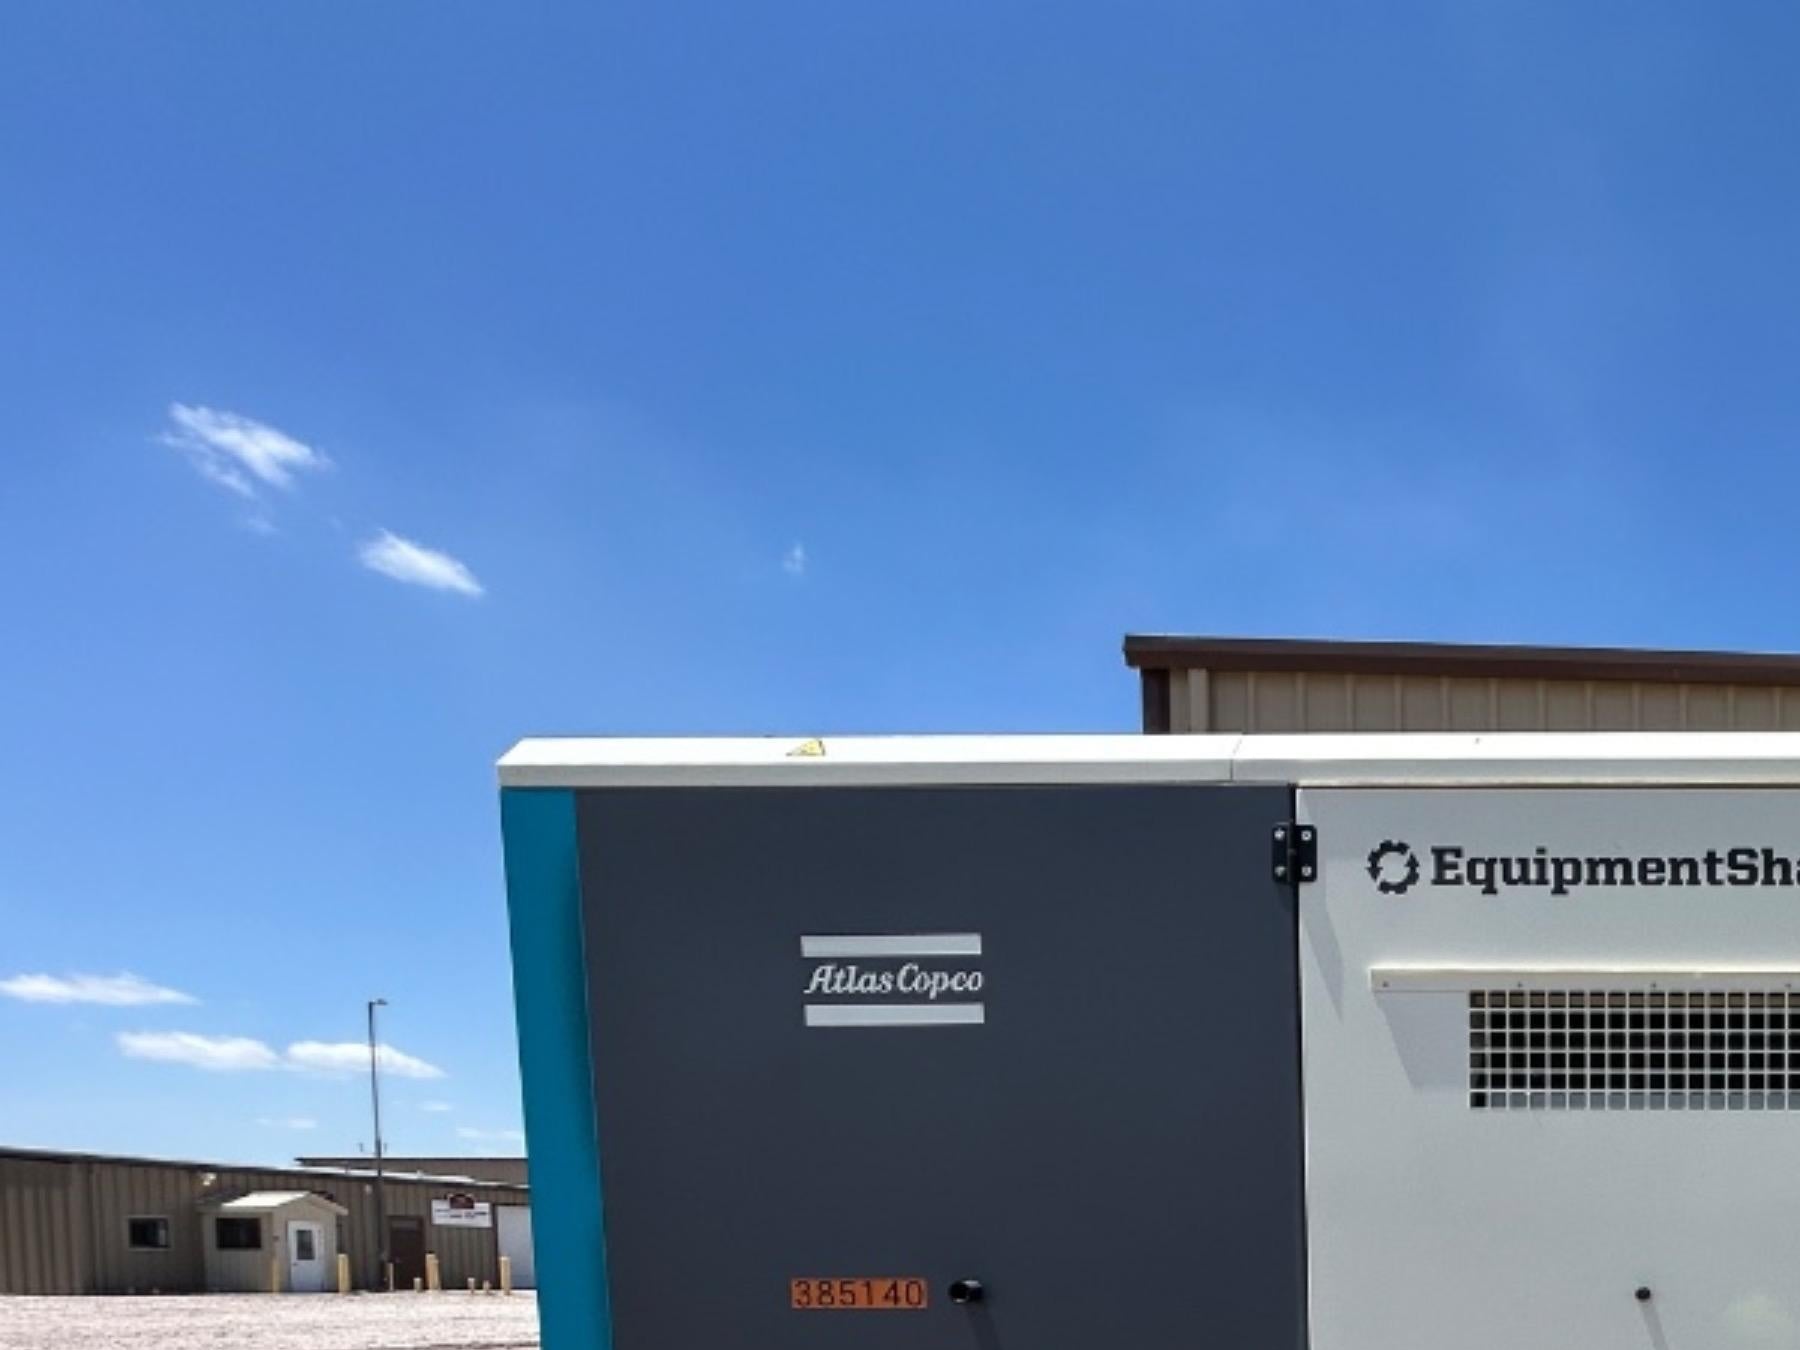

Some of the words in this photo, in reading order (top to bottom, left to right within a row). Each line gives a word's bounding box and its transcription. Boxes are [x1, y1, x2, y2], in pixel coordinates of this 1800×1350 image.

[803, 961, 895, 994] Atlas
[896, 961, 985, 1000] Copco
[794, 1279, 923, 1307] 385140
